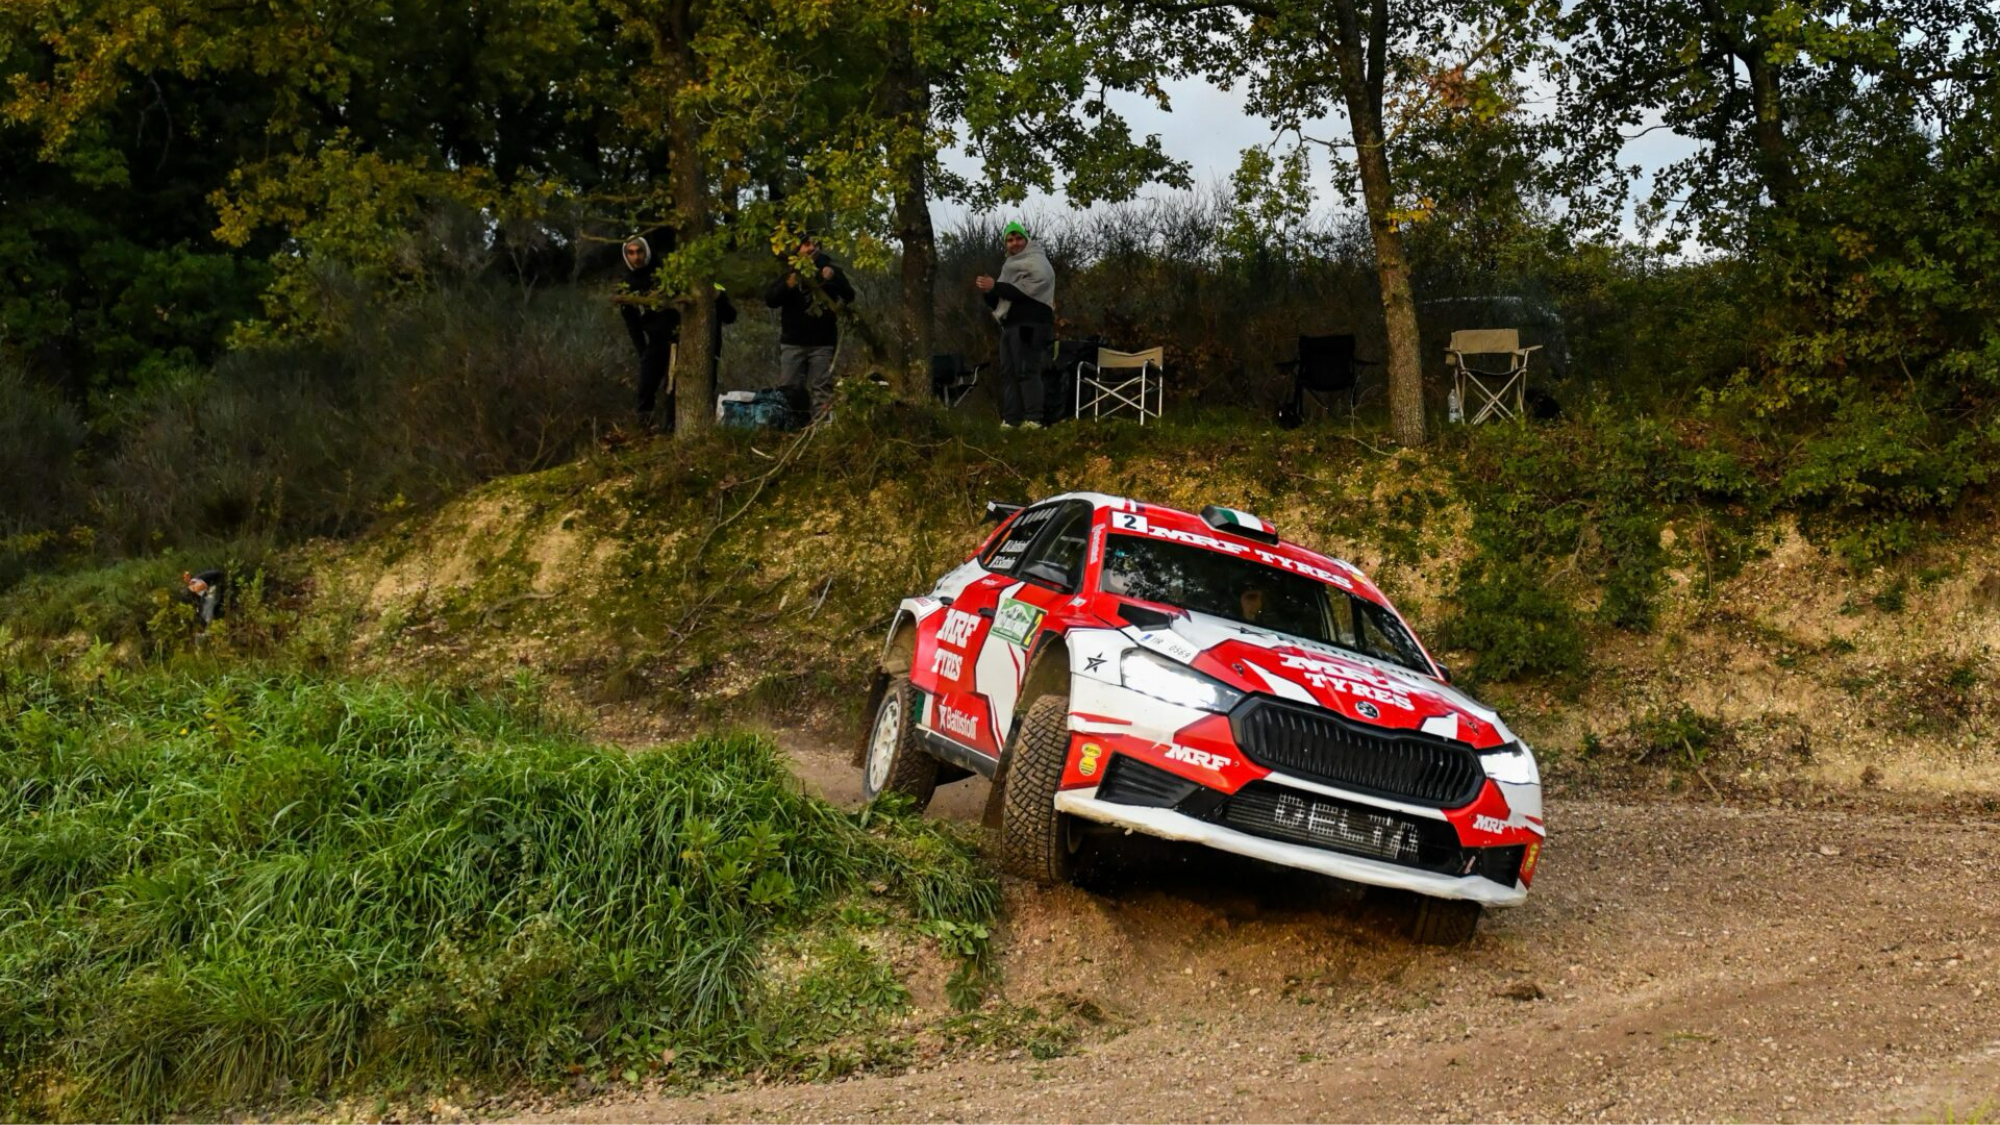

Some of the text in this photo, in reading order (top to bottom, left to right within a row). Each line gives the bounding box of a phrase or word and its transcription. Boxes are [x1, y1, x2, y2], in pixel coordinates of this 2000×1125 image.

[1123, 514, 1137, 530] 2
[1149, 526, 1353, 589] MRF TYRES
[936, 608, 981, 648] MRF
[1023, 613, 1043, 646] 2
[931, 649, 963, 682] TYRES
[1304, 672, 1415, 711] TYRES
[1164, 743, 1232, 772] MRF
[1472, 814, 1506, 835] MRF
